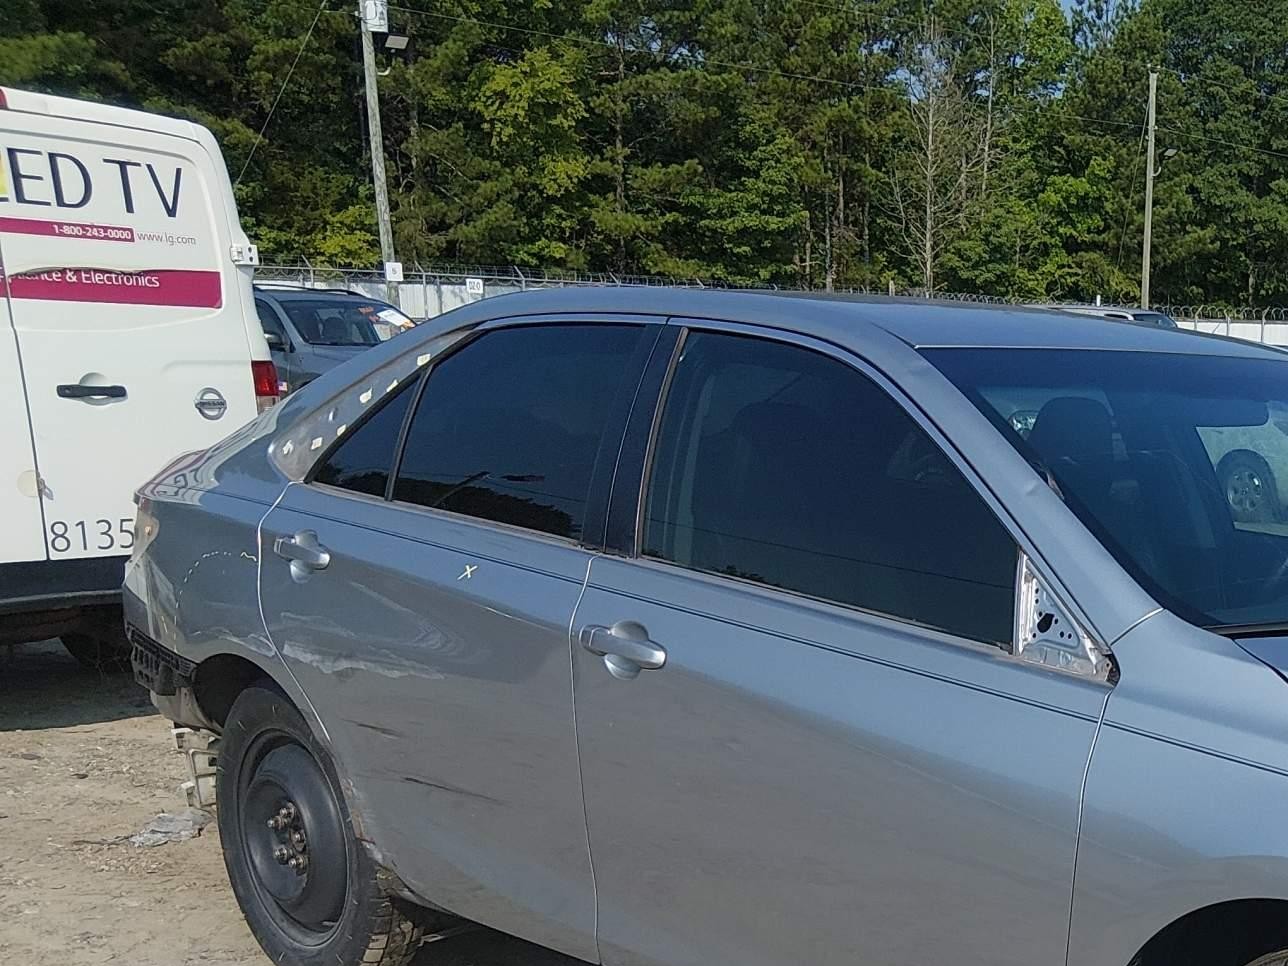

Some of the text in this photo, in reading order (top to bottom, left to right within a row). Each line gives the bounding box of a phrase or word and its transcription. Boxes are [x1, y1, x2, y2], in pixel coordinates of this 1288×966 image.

[0, 147, 182, 218] ED TV
[53, 224, 197, 246] 1-800-243-0000 www.lg.com
[66, 269, 78, 283] &
[81, 271, 160, 287] Electronics
[50, 518, 135, 552] 8135
